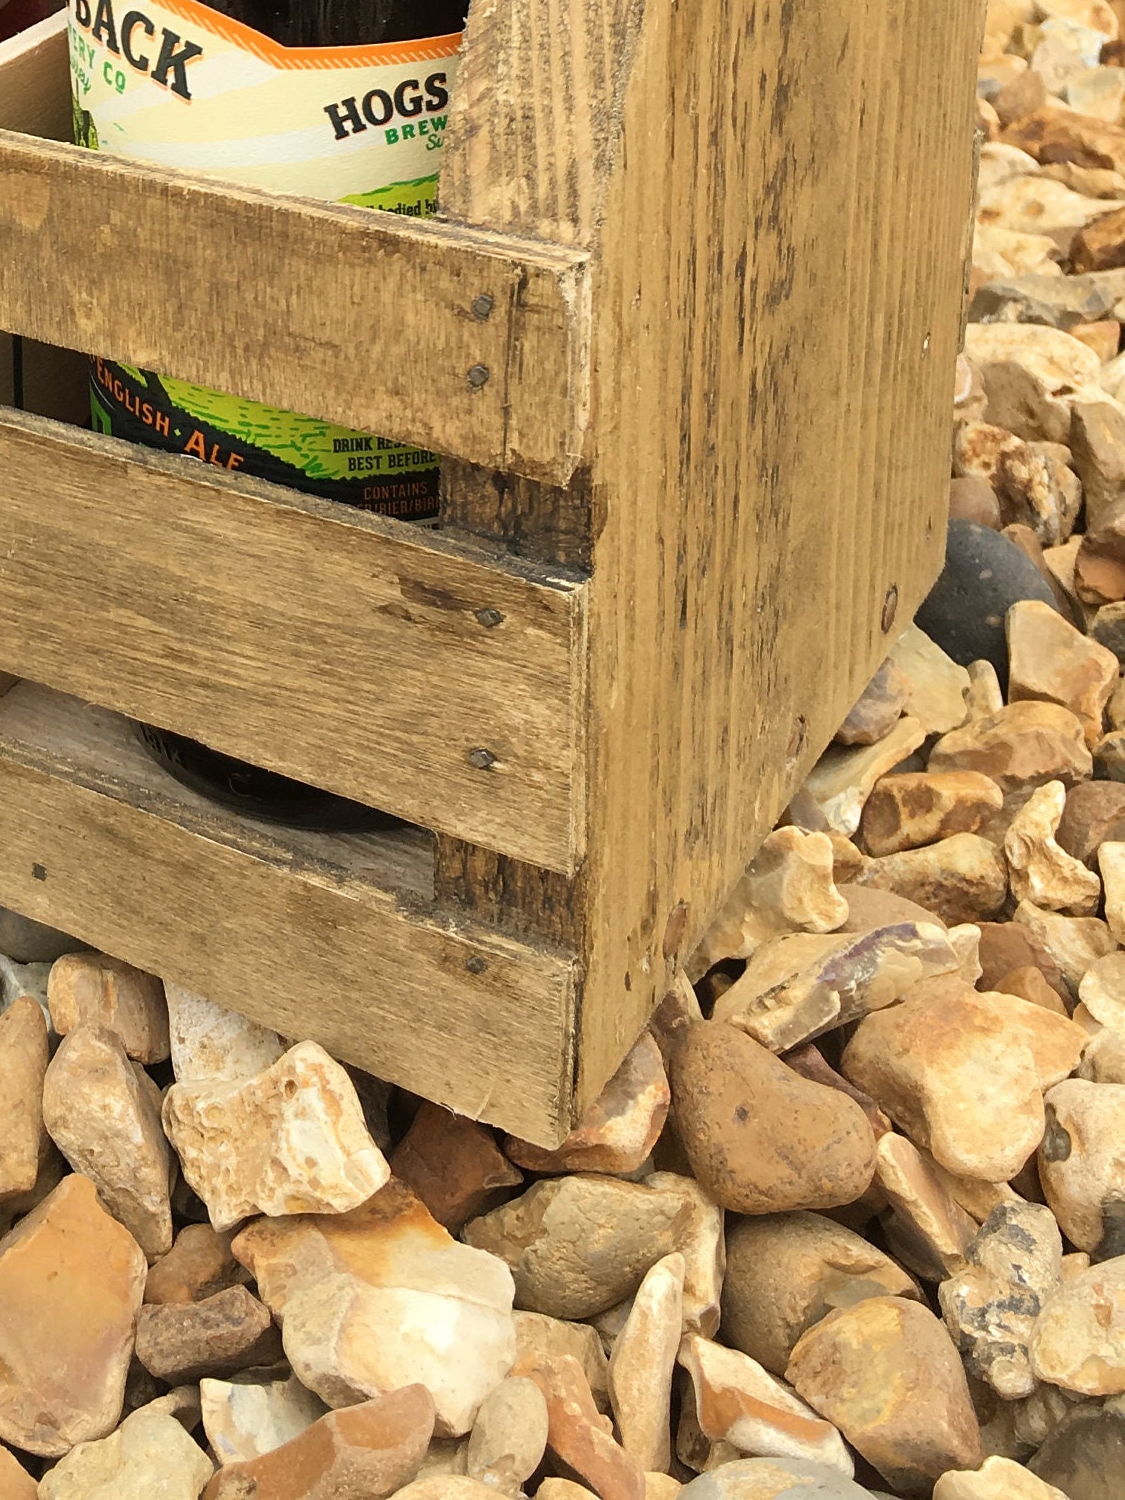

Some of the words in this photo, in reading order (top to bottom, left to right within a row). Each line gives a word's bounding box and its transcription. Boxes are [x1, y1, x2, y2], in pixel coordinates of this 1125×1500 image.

[323, 72, 449, 141] HOGS
[385, 115, 449, 145] BREW
[95, 356, 170, 437] ENGLISH
[333, 437, 373, 453] DRINK
[348, 456, 382, 472] BEST
[388, 450, 436, 469] BEFORE
[364, 481, 428, 500] CONTAINS
